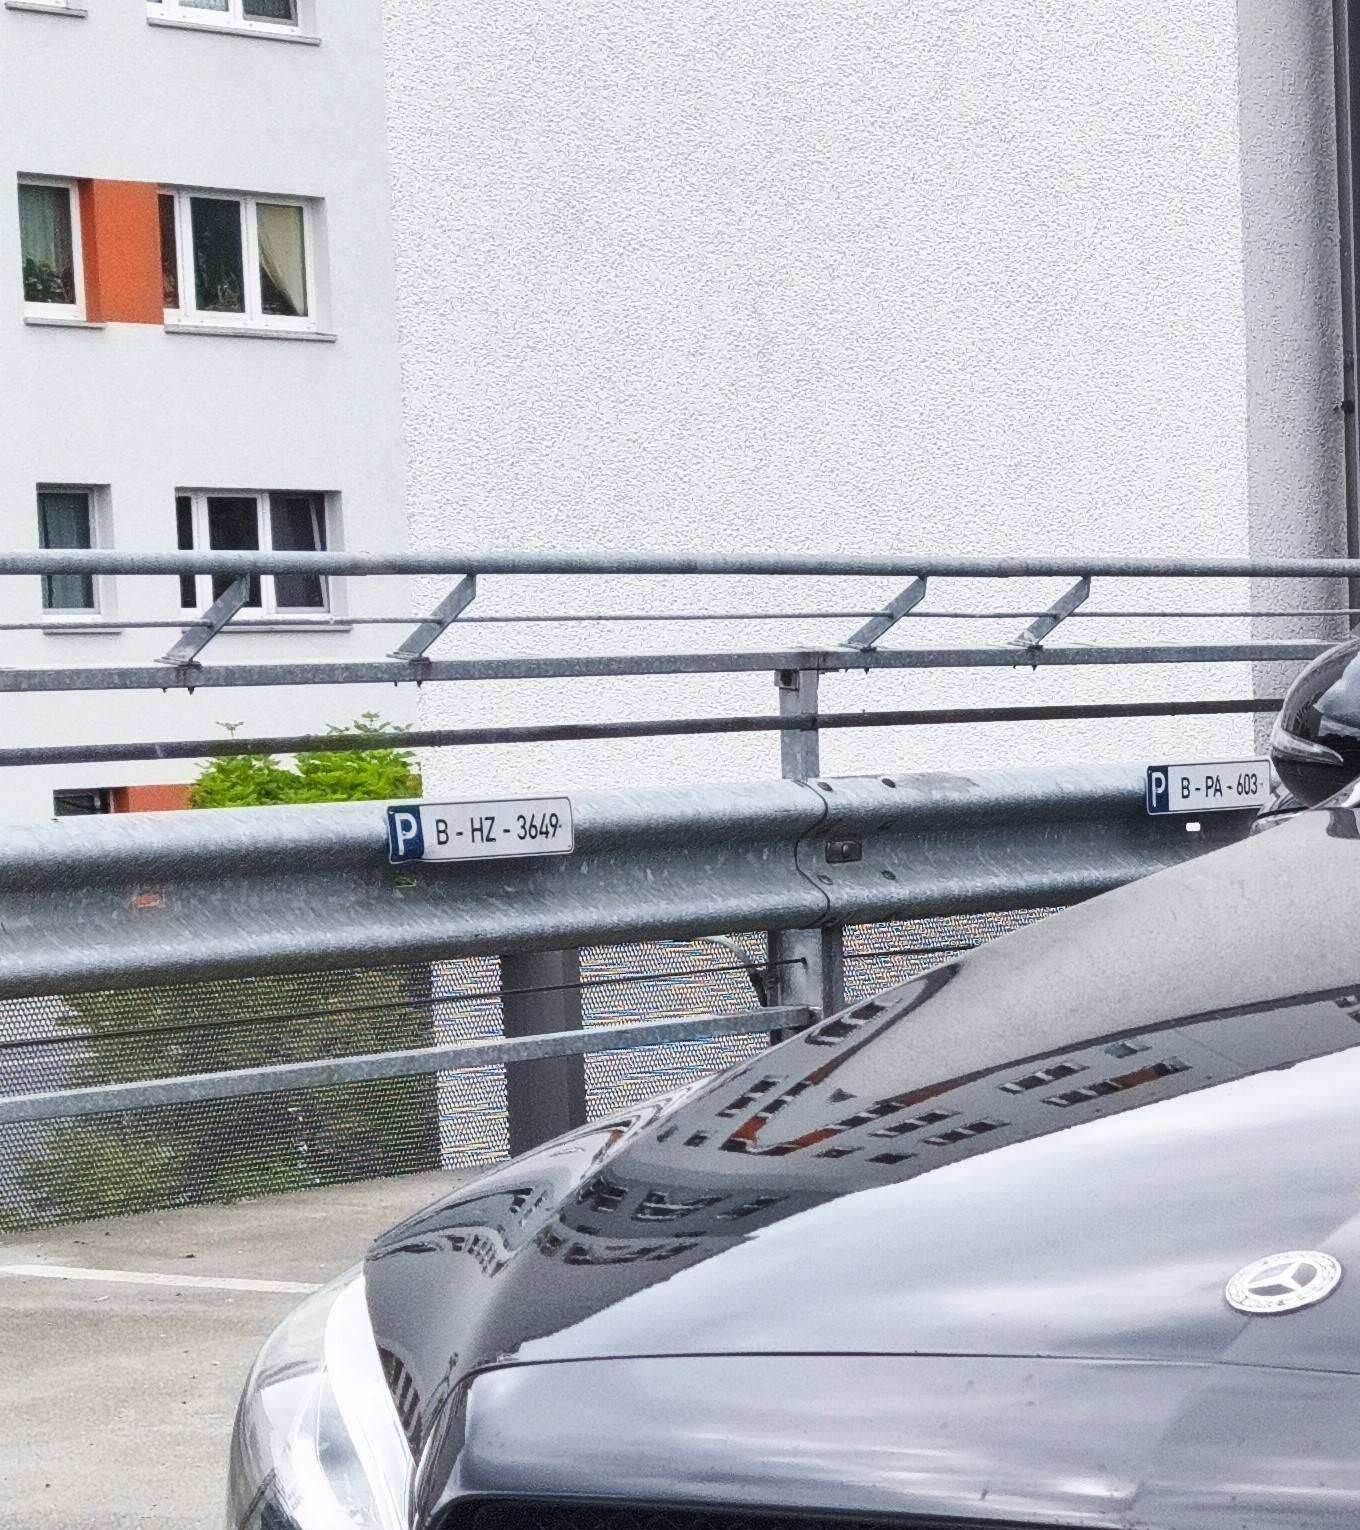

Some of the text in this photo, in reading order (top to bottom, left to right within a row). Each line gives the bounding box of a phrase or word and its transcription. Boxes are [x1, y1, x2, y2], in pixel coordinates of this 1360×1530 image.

[1152, 772, 1166, 807] P
[1181, 777, 1190, 798] B
[1206, 775, 1222, 797] PA
[1237, 774, 1257, 795] 603
[394, 813, 417, 855] P
[436, 819, 449, 845] B
[471, 817, 496, 842] HZ
[517, 813, 559, 840] 3649
